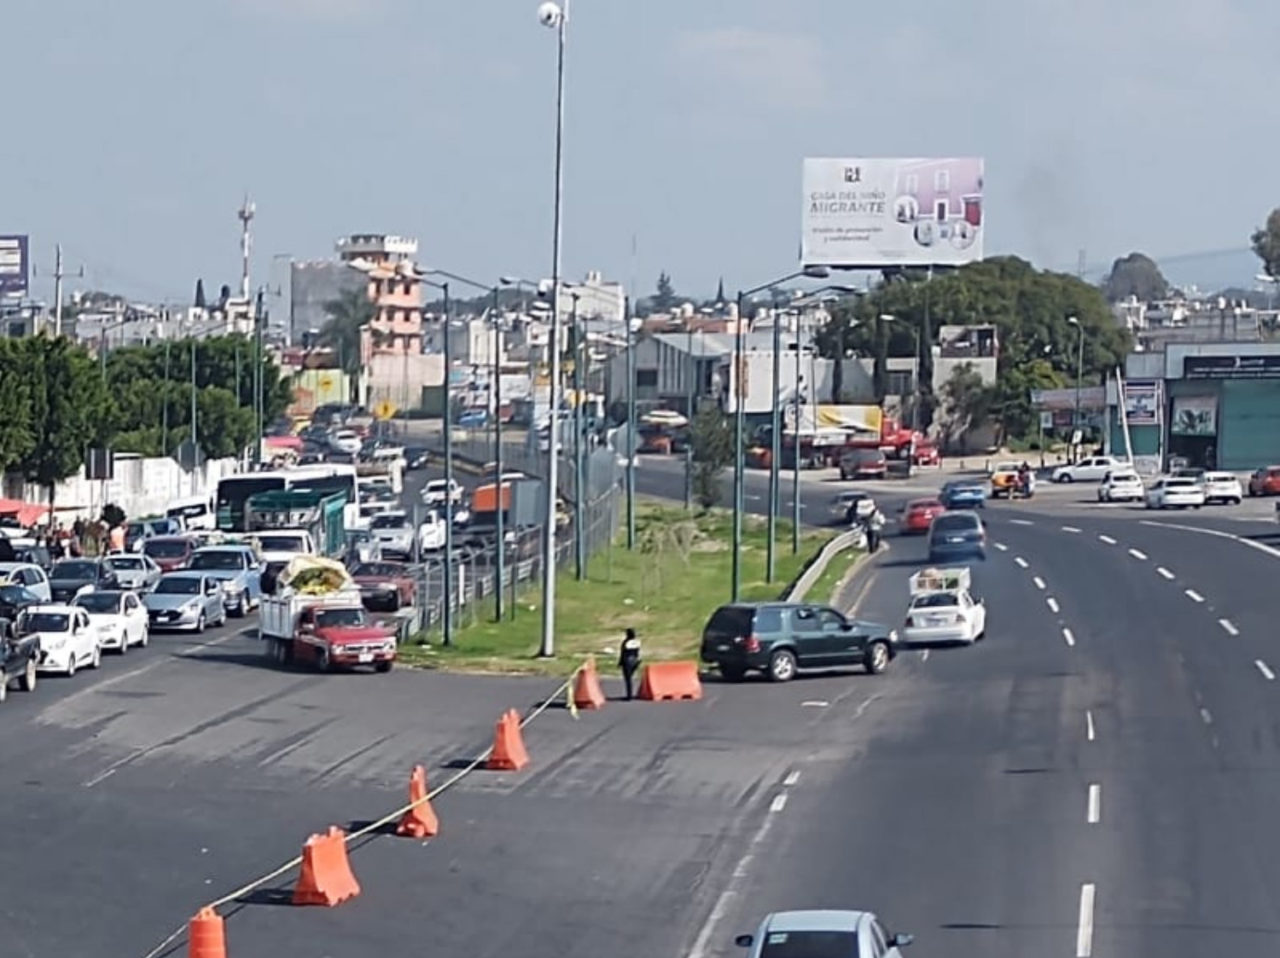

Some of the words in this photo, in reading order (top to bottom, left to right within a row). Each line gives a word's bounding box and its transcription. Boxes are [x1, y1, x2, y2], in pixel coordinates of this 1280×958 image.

[810, 191, 836, 201] CASA
[838, 191, 857, 201] DEL
[809, 202, 887, 213] MIGRANTE
